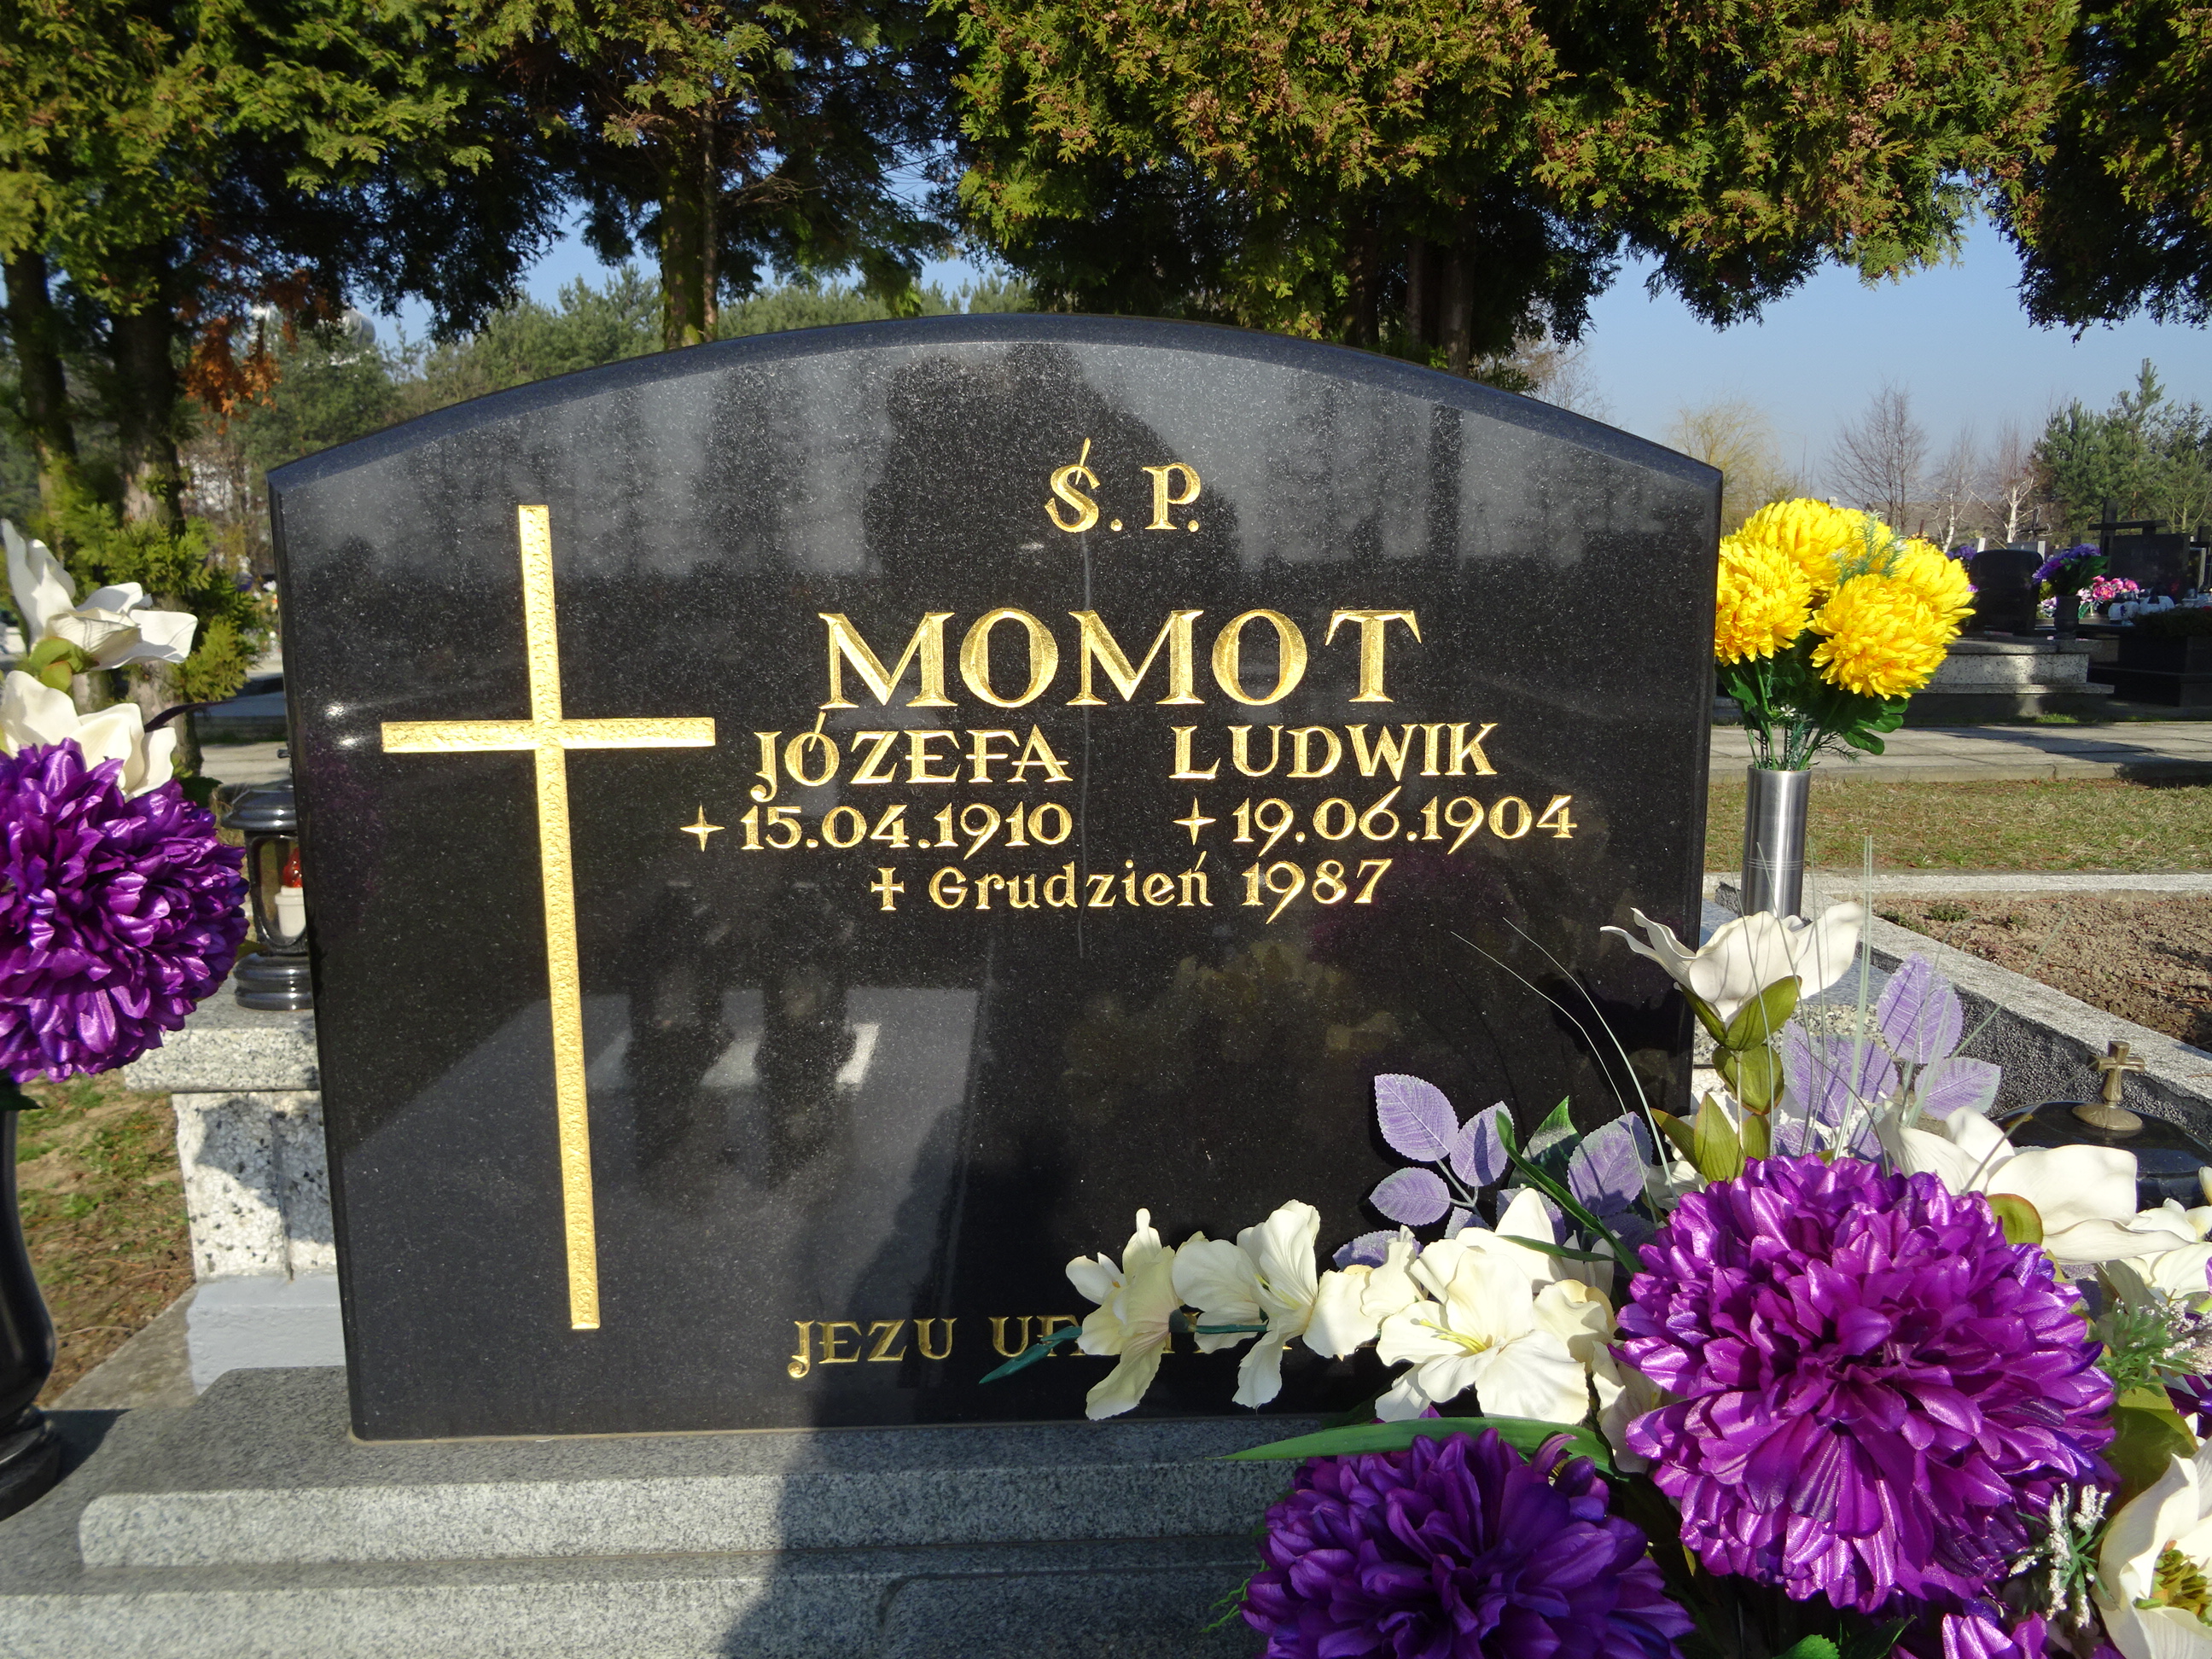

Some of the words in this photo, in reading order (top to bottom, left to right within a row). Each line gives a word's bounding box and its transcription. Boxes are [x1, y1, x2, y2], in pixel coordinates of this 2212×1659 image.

[817, 606, 1423, 711] MOMOT
[748, 710, 1074, 804] JÓZEFA
[1167, 721, 1499, 783] LUDWIK
[739, 800, 1074, 860] 15.04.1910
[1231, 785, 1579, 858] 19.06.1904
[928, 851, 1214, 911] Grudzień
[1241, 858, 1394, 924] 1987
[787, 1317, 958, 1380] JEZU
